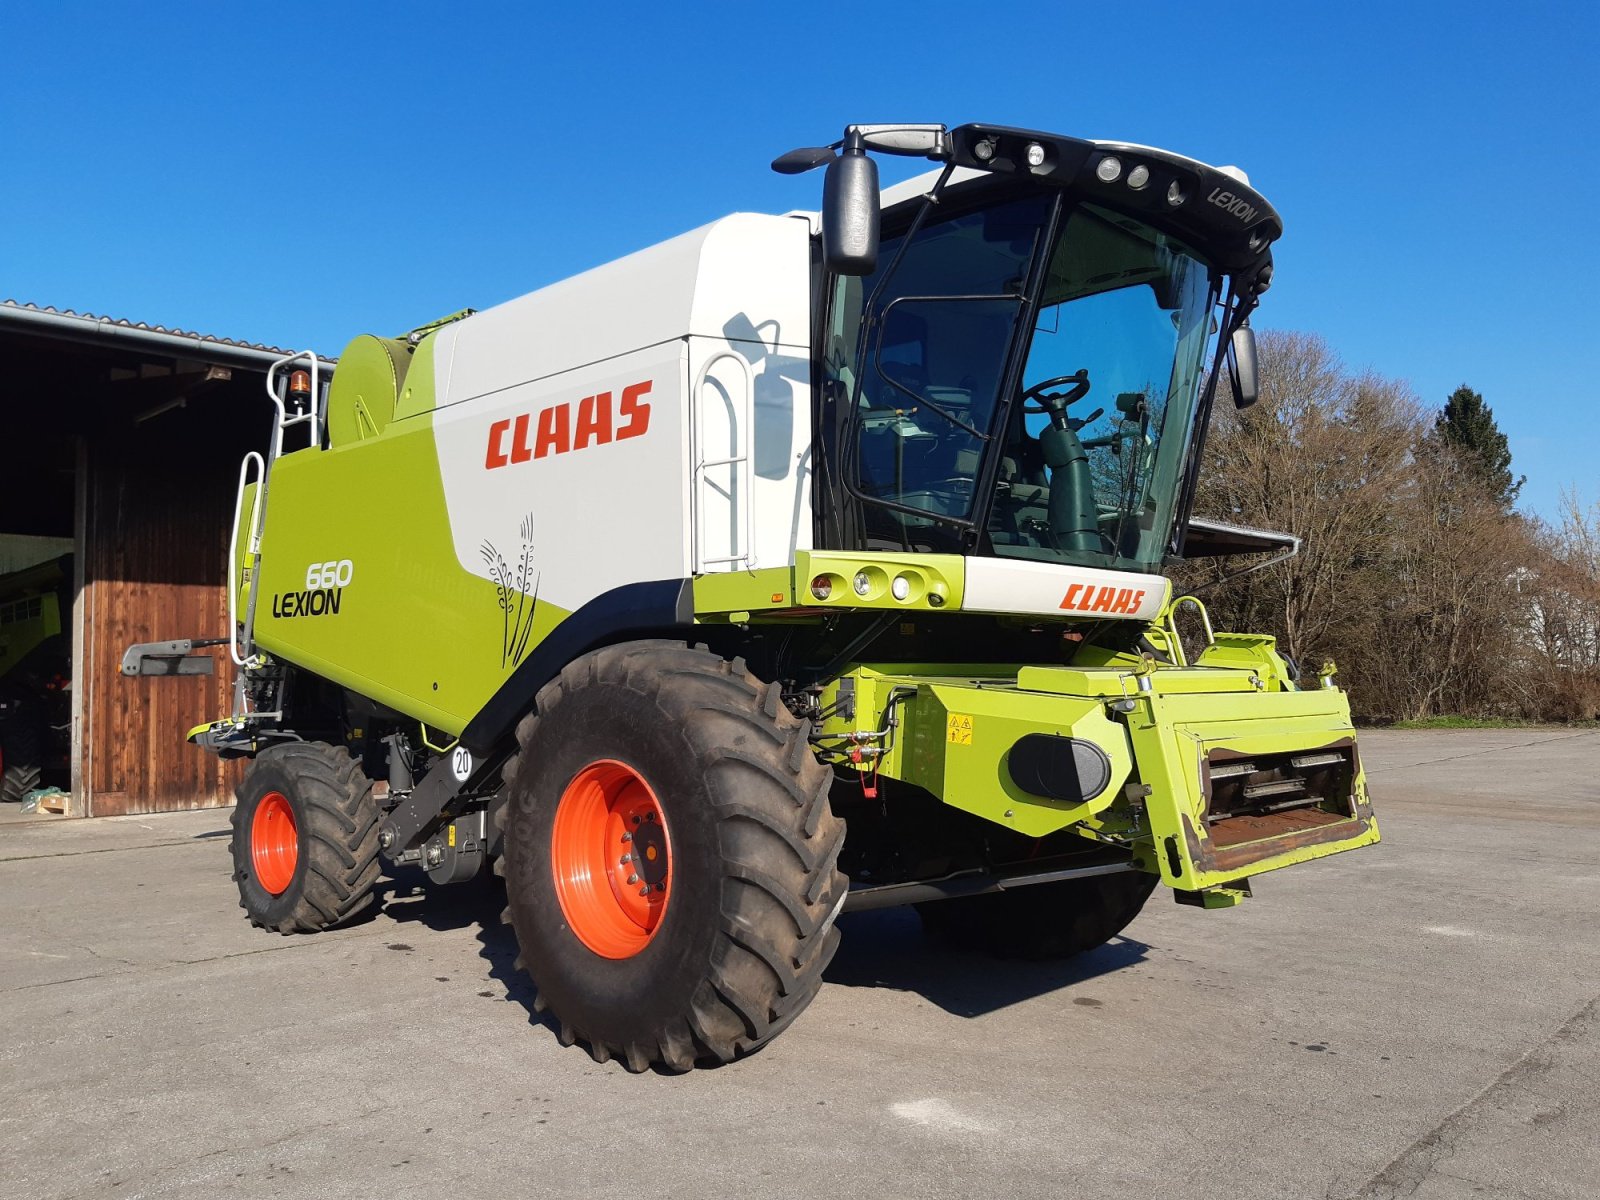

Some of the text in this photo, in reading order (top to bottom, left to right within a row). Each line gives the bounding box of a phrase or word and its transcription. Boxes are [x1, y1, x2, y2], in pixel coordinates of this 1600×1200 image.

[1207, 187, 1258, 223] LEXION
[486, 380, 652, 470] CLAAS
[305, 559, 354, 590] 660
[272, 588, 342, 618] LEXION
[1060, 584, 1146, 615] CLAAS
[456, 751, 470, 774] 20
